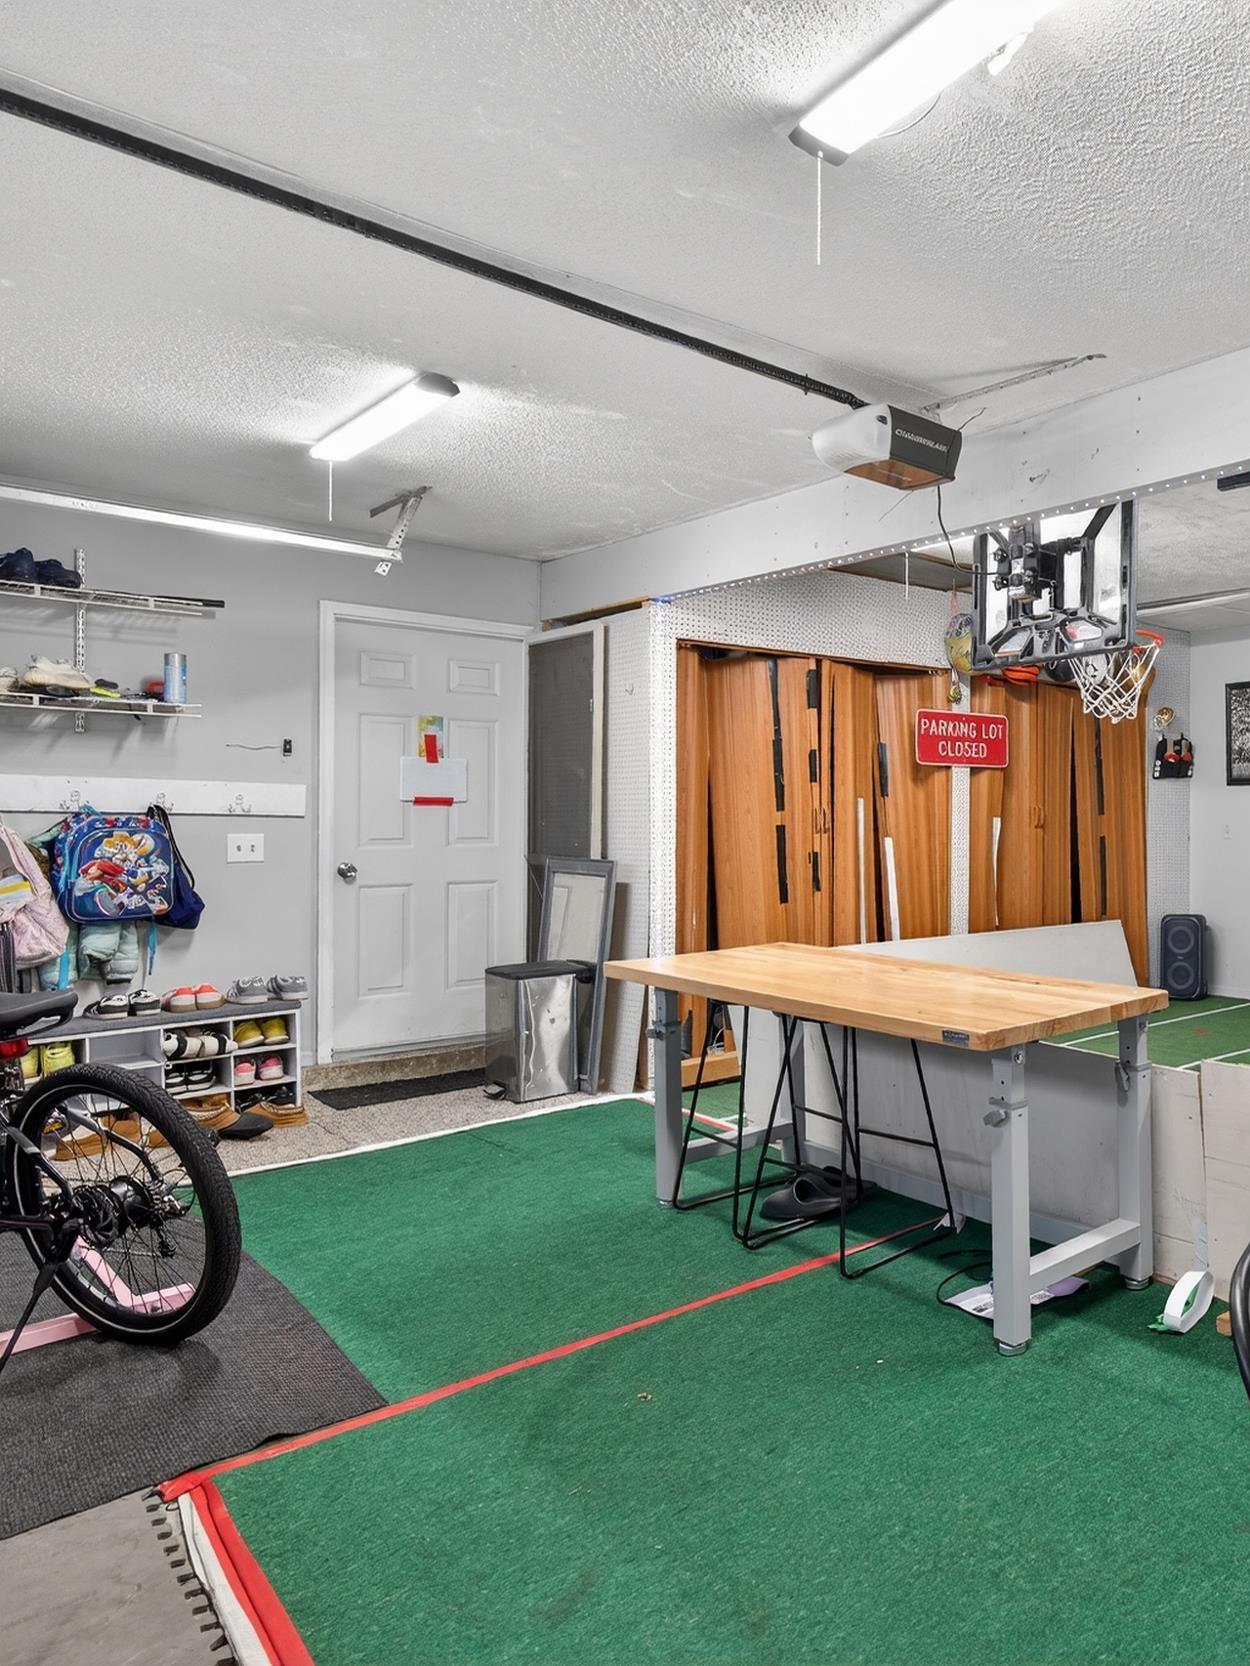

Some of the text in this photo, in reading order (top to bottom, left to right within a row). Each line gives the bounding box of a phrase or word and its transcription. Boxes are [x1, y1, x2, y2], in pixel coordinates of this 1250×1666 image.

[920, 719, 1003, 739] PARKING LOT
[938, 741, 987, 758] CLOSED
